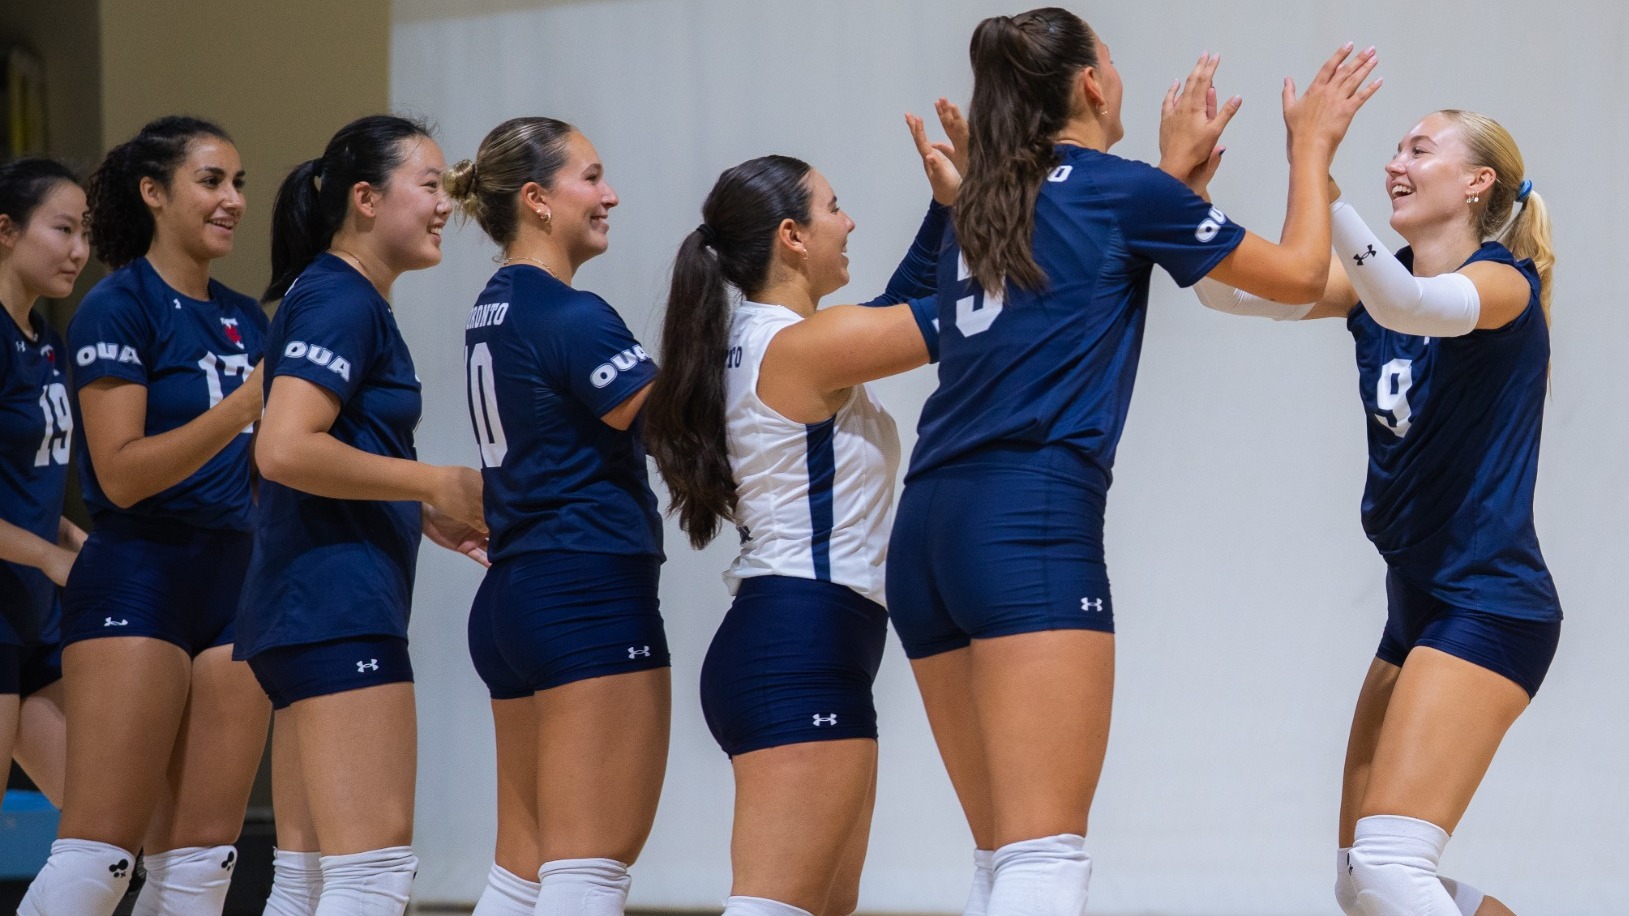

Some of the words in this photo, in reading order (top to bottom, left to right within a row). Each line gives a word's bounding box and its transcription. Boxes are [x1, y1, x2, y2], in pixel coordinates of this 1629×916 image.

[1194, 206, 1227, 243] OU
[76, 341, 143, 367] OUA
[284, 340, 351, 382] OUA
[34, 382, 74, 467] 19
[464, 342, 508, 468] 0
[1375, 358, 1413, 438] 9
